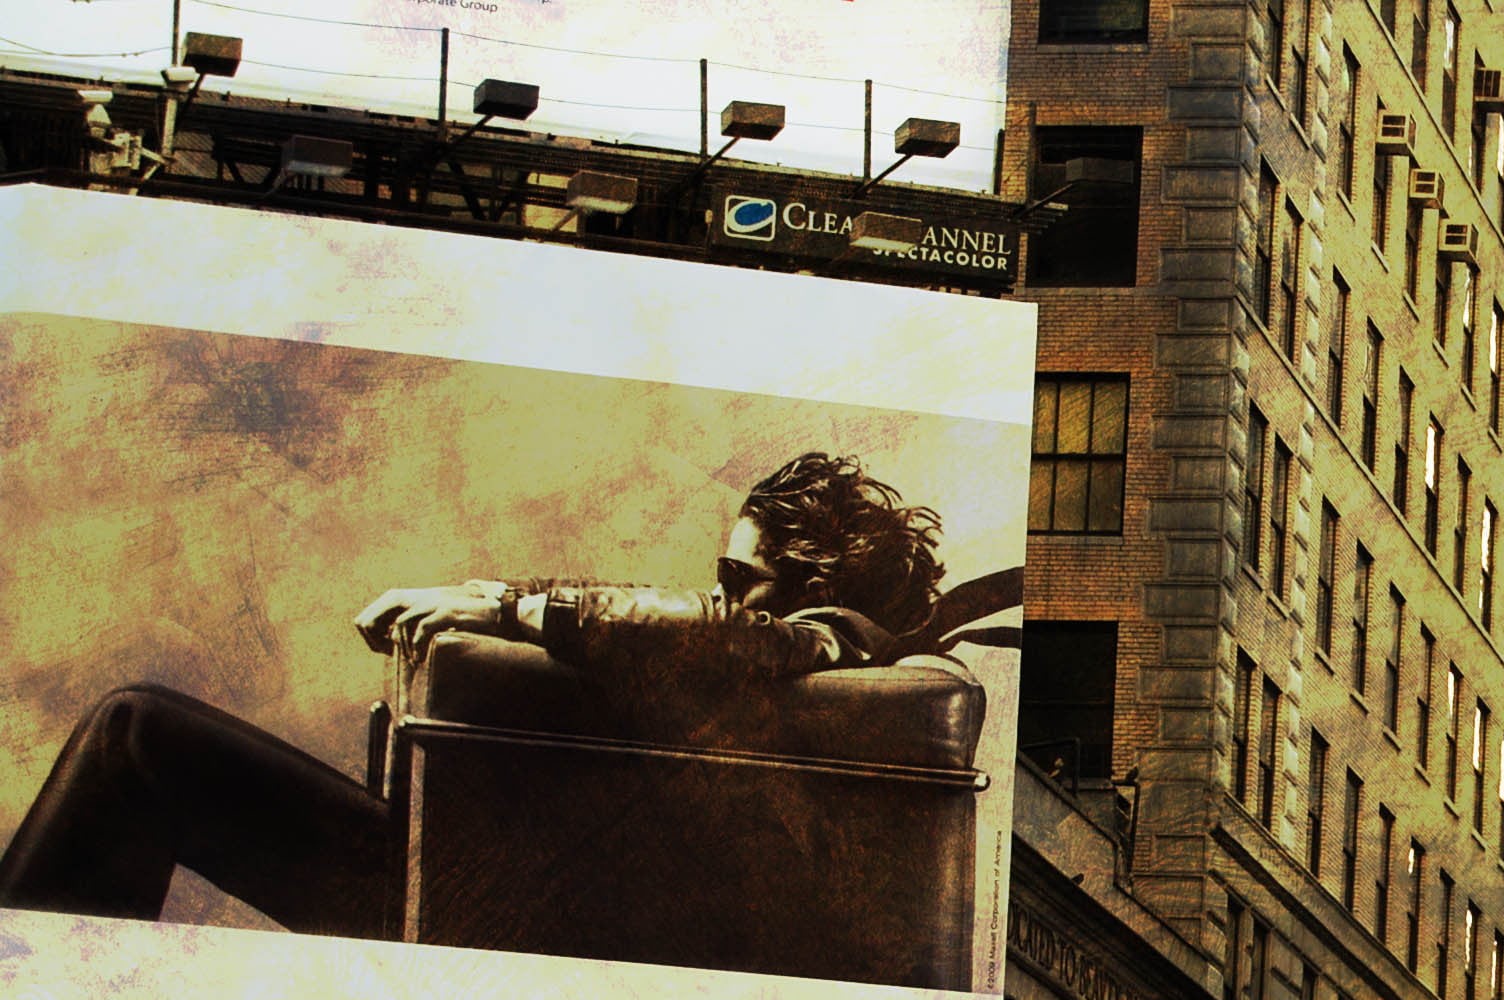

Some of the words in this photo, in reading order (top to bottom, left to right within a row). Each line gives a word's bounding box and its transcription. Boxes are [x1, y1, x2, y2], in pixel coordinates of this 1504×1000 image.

[460, 0, 498, 13] Group
[782, 202, 853, 236] CLEA
[921, 226, 1012, 256] ANNEL
[990, 879, 1000, 931] Corporation
